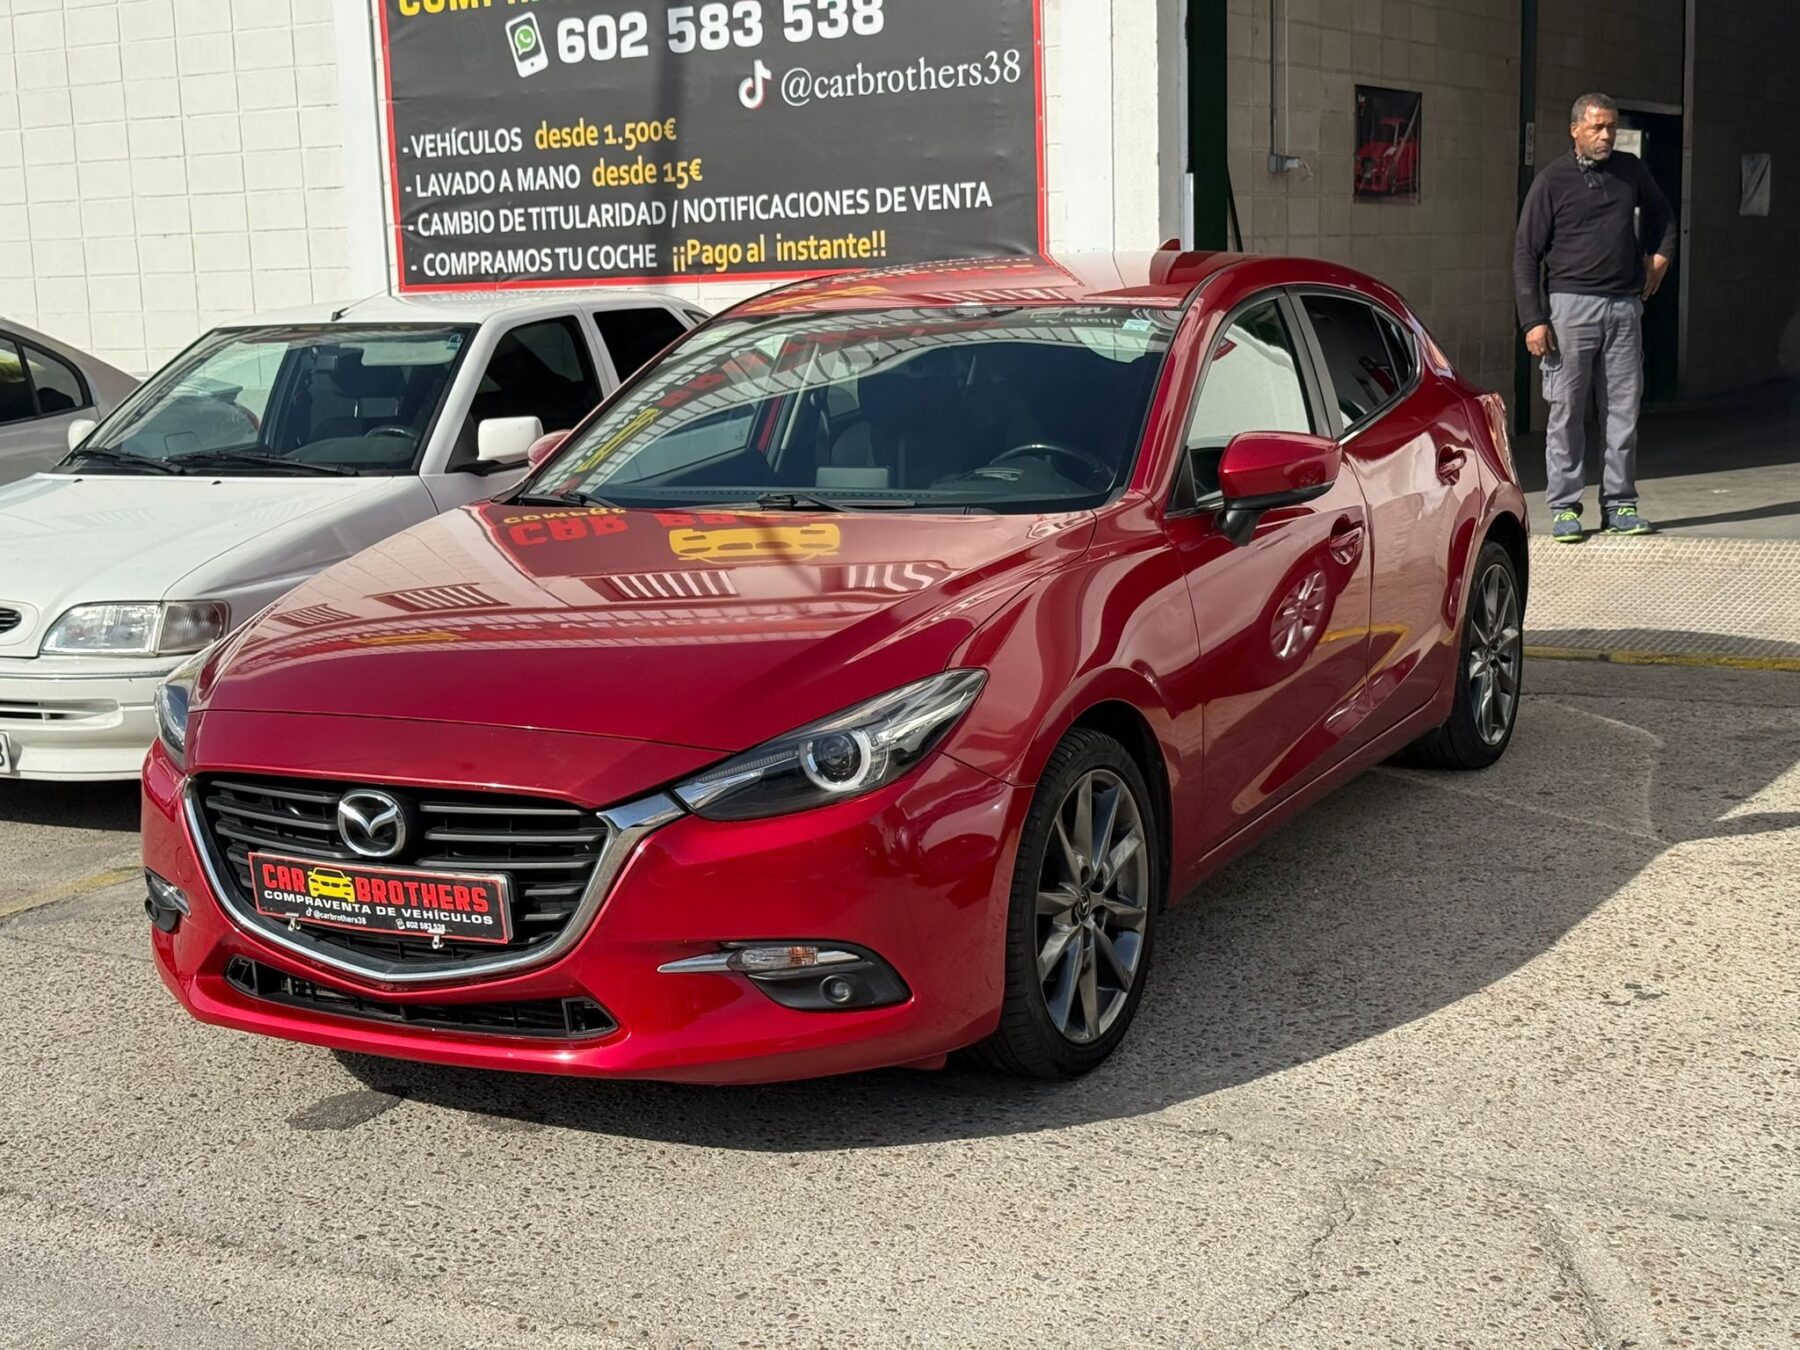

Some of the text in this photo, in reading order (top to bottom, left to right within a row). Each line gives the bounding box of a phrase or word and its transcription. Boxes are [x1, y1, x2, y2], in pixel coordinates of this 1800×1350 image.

[557, 0, 884, 63] 602 583 538
[781, 49, 1020, 106] @carbrothers38
[411, 128, 522, 158] VEHÍCULOS
[535, 118, 598, 149] desde
[604, 119, 676, 150] 1.500€
[416, 170, 495, 197] LAVADO
[499, 169, 513, 192] A
[517, 165, 580, 191] MANO
[593, 156, 656, 186] desde
[664, 159, 702, 189] 15€
[418, 210, 494, 236] CAMBIO
[500, 208, 526, 232] DE
[528, 202, 665, 230] TITULARIDAD
[684, 189, 869, 223] NOTIFICACIONES
[876, 187, 907, 213] DE
[910, 182, 992, 210] VENTA
[424, 248, 552, 276] COMPRAMOS
[555, 247, 582, 270] TU
[587, 245, 656, 270] COCHE
[747, 234, 765, 262] al
[777, 230, 886, 261] instante!!
[262, 863, 489, 912] CAR BROTHERS
[264, 890, 493, 925] COMPRAVENTA DE VEHÍCULOS
[313, 909, 367, 925] @carbrothers38
